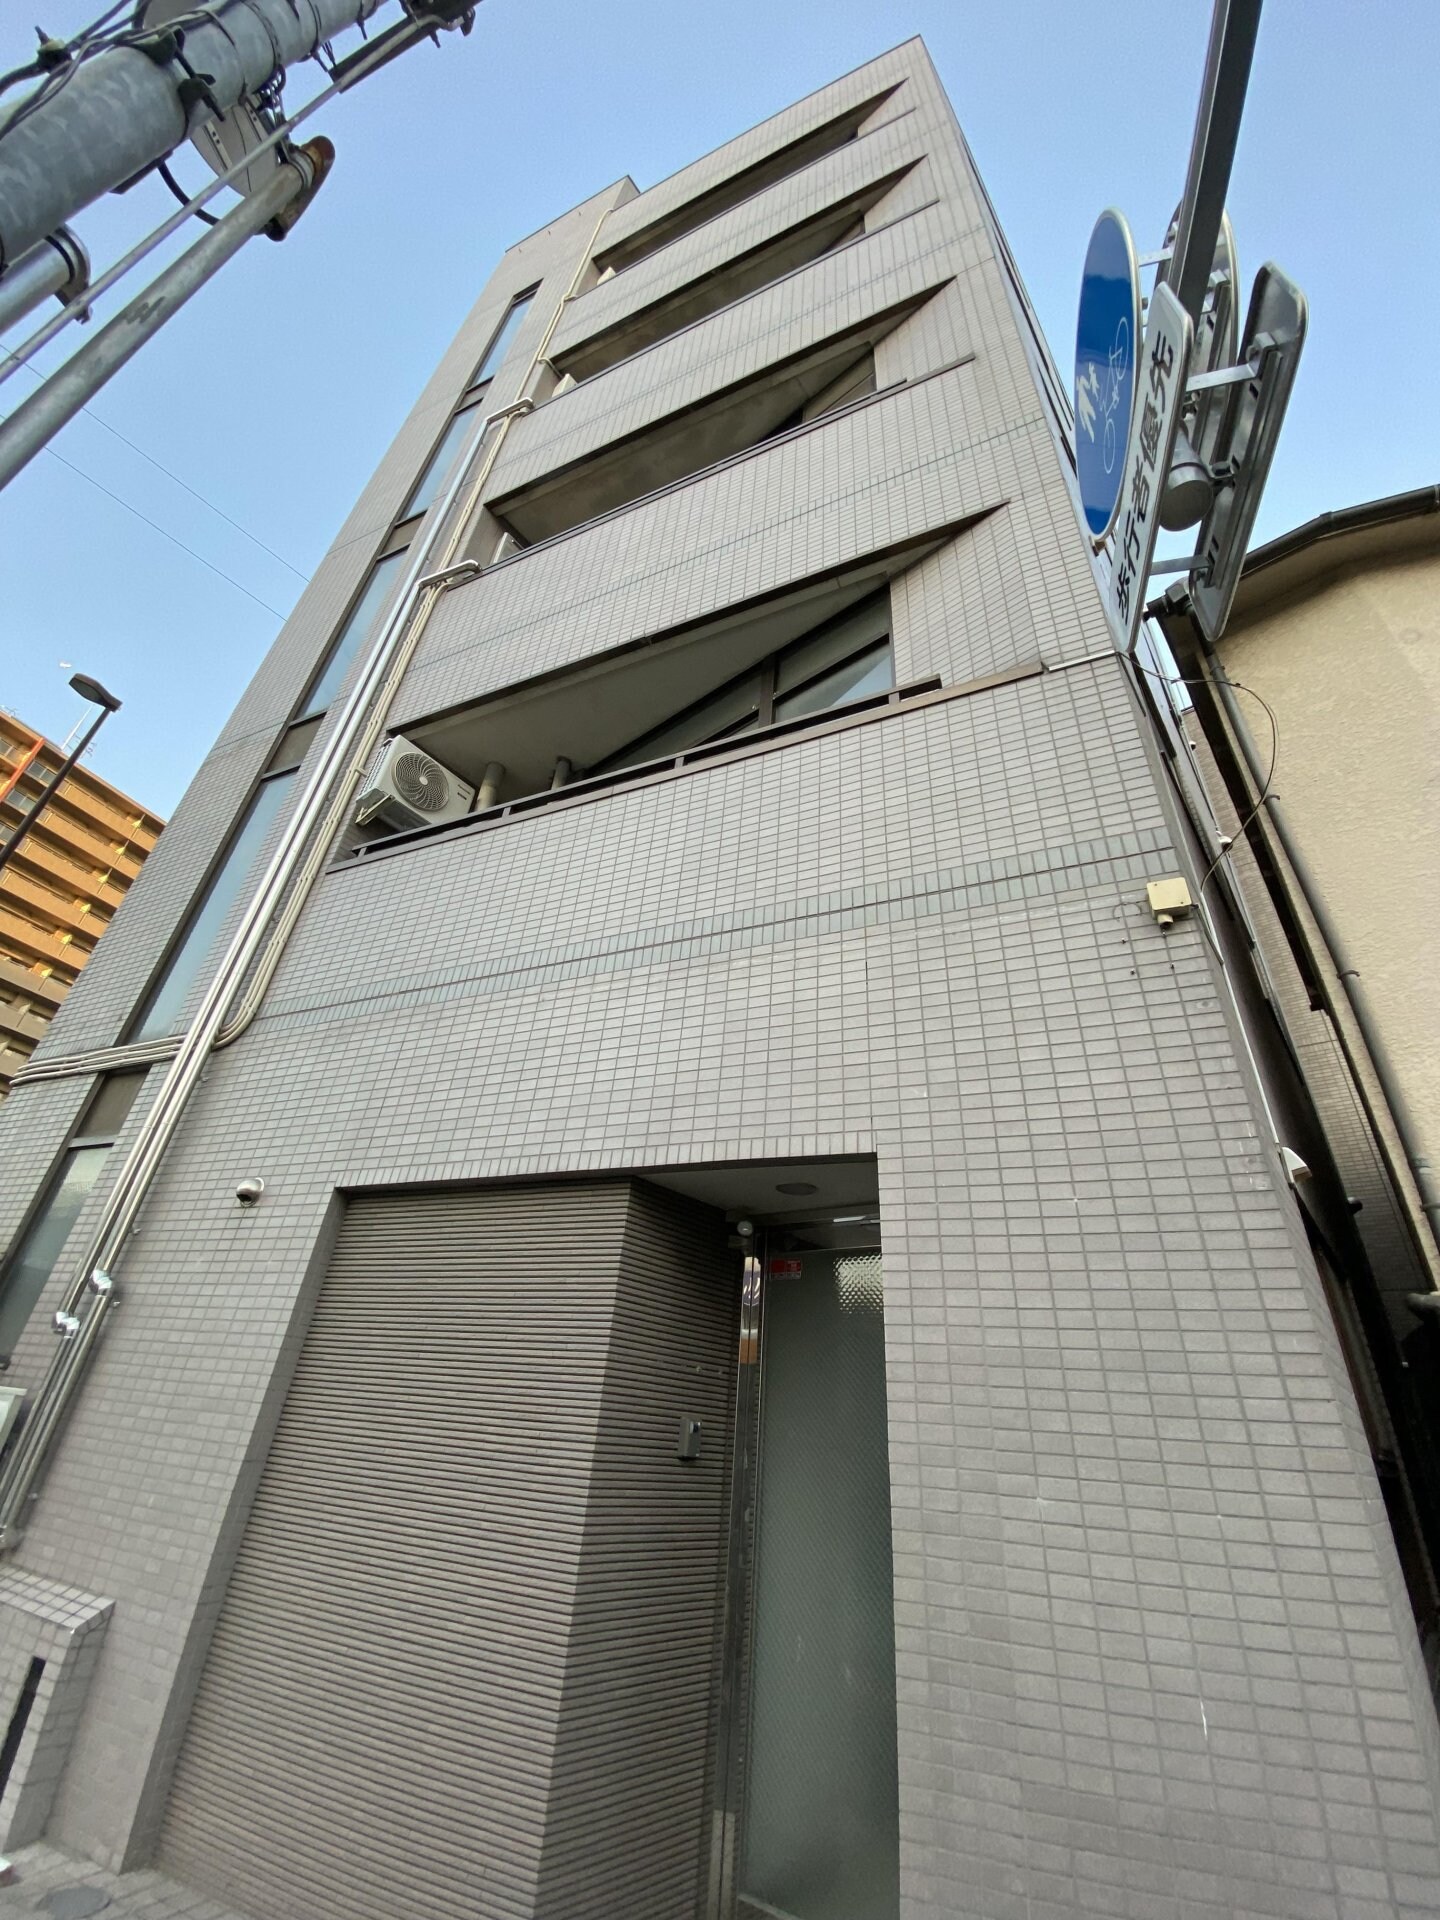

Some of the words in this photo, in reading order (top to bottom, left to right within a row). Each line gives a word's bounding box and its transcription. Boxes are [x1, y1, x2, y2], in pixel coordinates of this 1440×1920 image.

[1116, 330, 1174, 626] 歩行者優先
